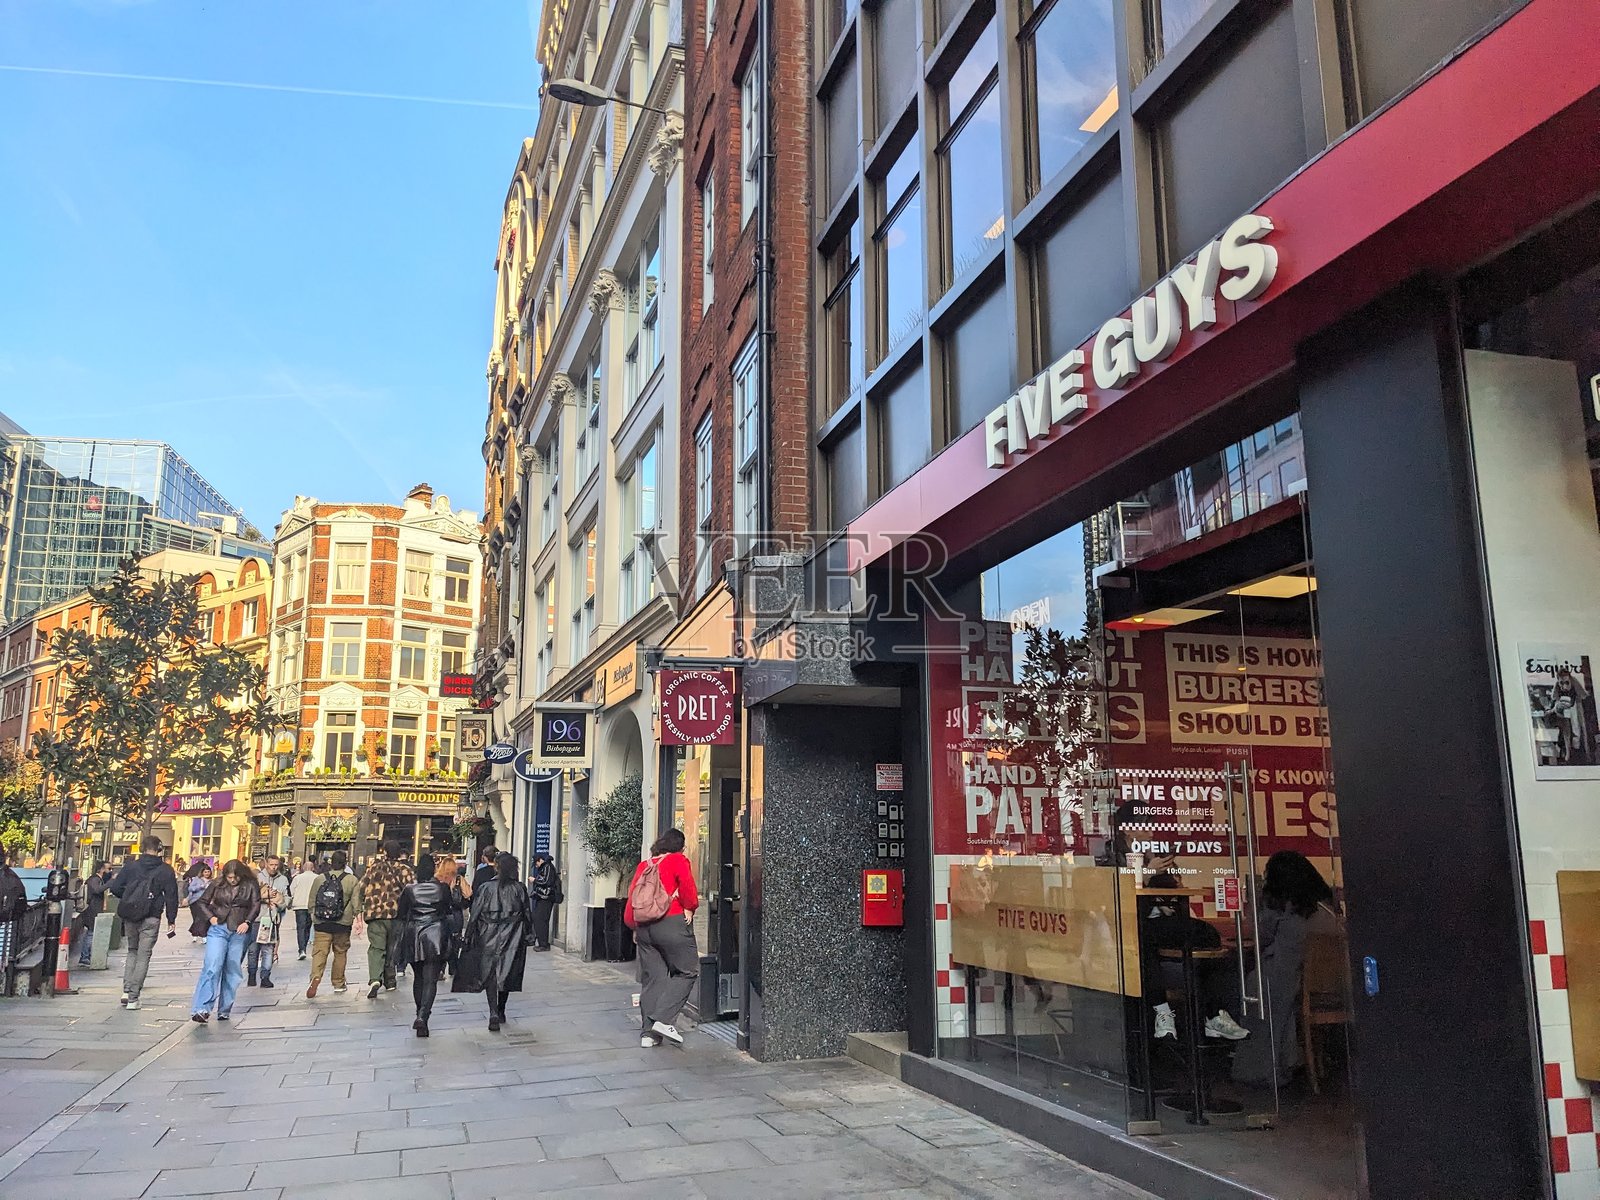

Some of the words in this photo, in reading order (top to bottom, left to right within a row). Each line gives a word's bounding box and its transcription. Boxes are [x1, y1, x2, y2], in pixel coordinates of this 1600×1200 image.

[985, 349, 1088, 468] FIVE
[1092, 214, 1279, 390] GUYS
[1010, 597, 1050, 634] OPEN
[1172, 643, 1230, 664] THIS
[1238, 645, 1260, 666] IS
[1267, 648, 1321, 668] HOW
[443, 686, 473, 695] DICKS
[665, 671, 699, 695] ORGANIC
[701, 673, 729, 696] COFFEE
[1177, 675, 1323, 705] BURGERS
[678, 694, 718, 721] PRET
[546, 719, 581, 741] 196
[663, 713, 692, 742] FRESHLY
[693, 732, 717, 744] MADE
[716, 714, 731, 735] FOOD
[1177, 712, 1287, 736] SHOULD
[1295, 717, 1330, 738] BE
[487, 746, 514, 760] Boots
[546, 744, 581, 754] Bishopsgate
[1226, 748, 1249, 756] PUSH
[964, 765, 1037, 785] HAND
[1221, 769, 1270, 784] YS
[397, 791, 460, 803] WOODIN'S
[1121, 785, 1165, 801] FIVE
[1170, 786, 1224, 802] GUYS
[181, 795, 213, 811] NatWest
[1133, 806, 1173, 816] BURGERS
[1175, 807, 1190, 817] and
[1191, 807, 1215, 817] FRIES
[122, 832, 138, 842] 222
[967, 838, 994, 846] Southern
[993, 839, 1010, 848] Living
[1131, 840, 1170, 853] OPEN
[1174, 842, 1182, 853] 7
[1186, 842, 1222, 853] DAYS
[1120, 867, 1136, 875] Mon
[1142, 867, 1157, 875] Sun
[1166, 867, 1198, 875] 10:00am
[998, 908, 1026, 930] FIVE
[1029, 910, 1068, 935] GUYS
